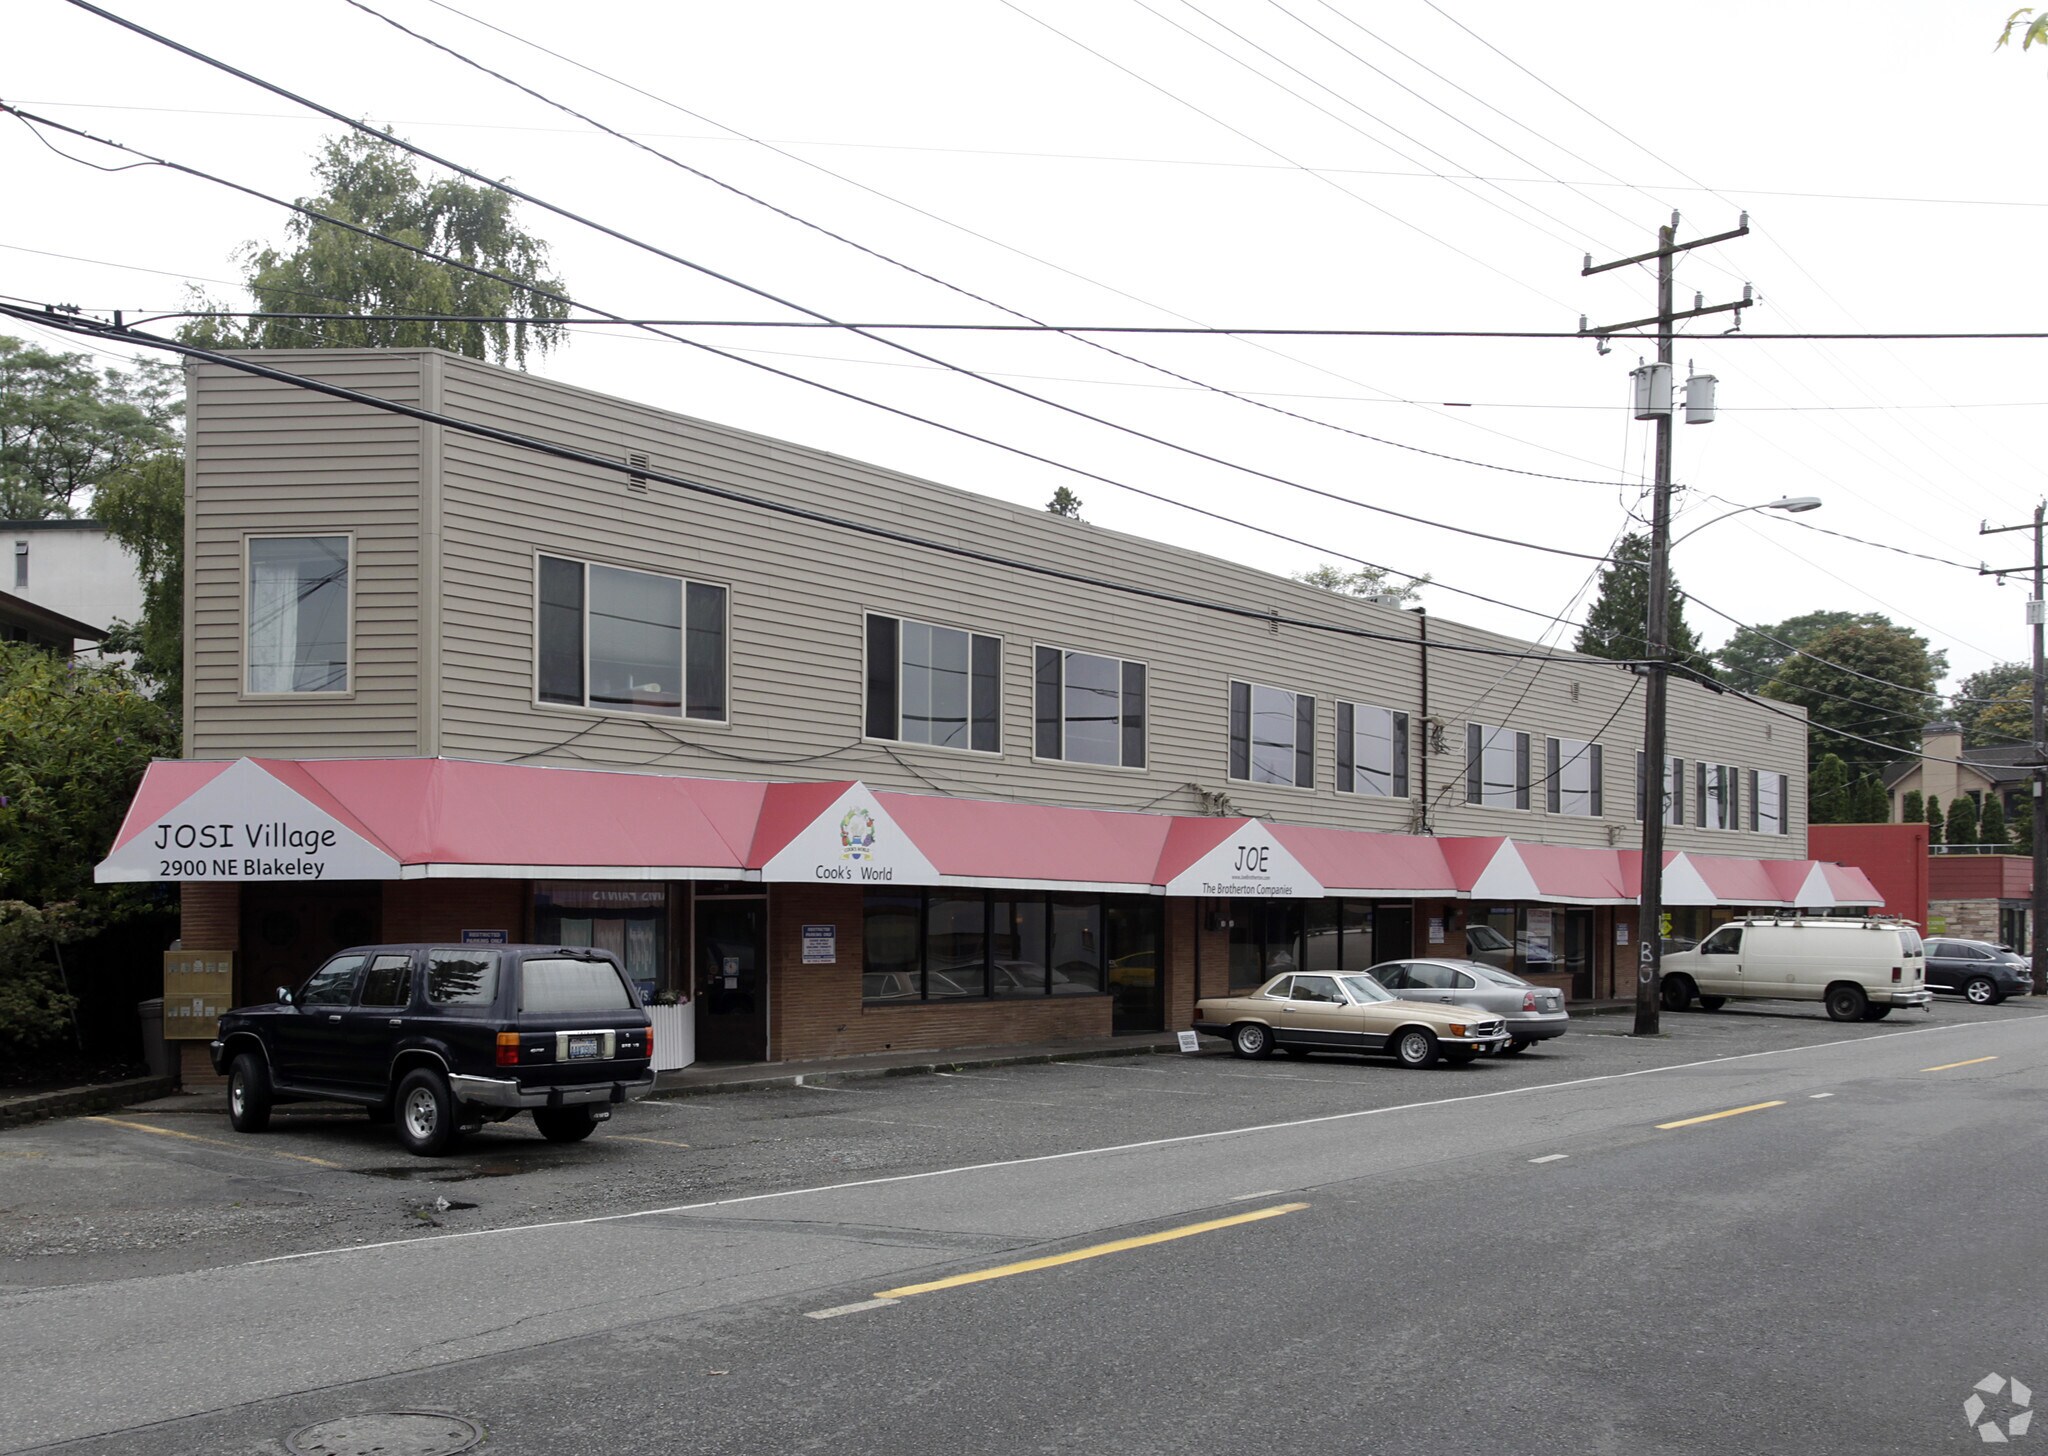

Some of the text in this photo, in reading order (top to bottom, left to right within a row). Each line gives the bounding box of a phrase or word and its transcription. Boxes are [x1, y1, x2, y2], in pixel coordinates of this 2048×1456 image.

[154, 822, 337, 855] JOSI Village
[159, 858, 325, 879] 2900 NE Blakeley
[1234, 845, 1270, 873] JOE
[815, 864, 893, 881] Cook's World
[1202, 882, 1292, 897] The Brotherton Companies
